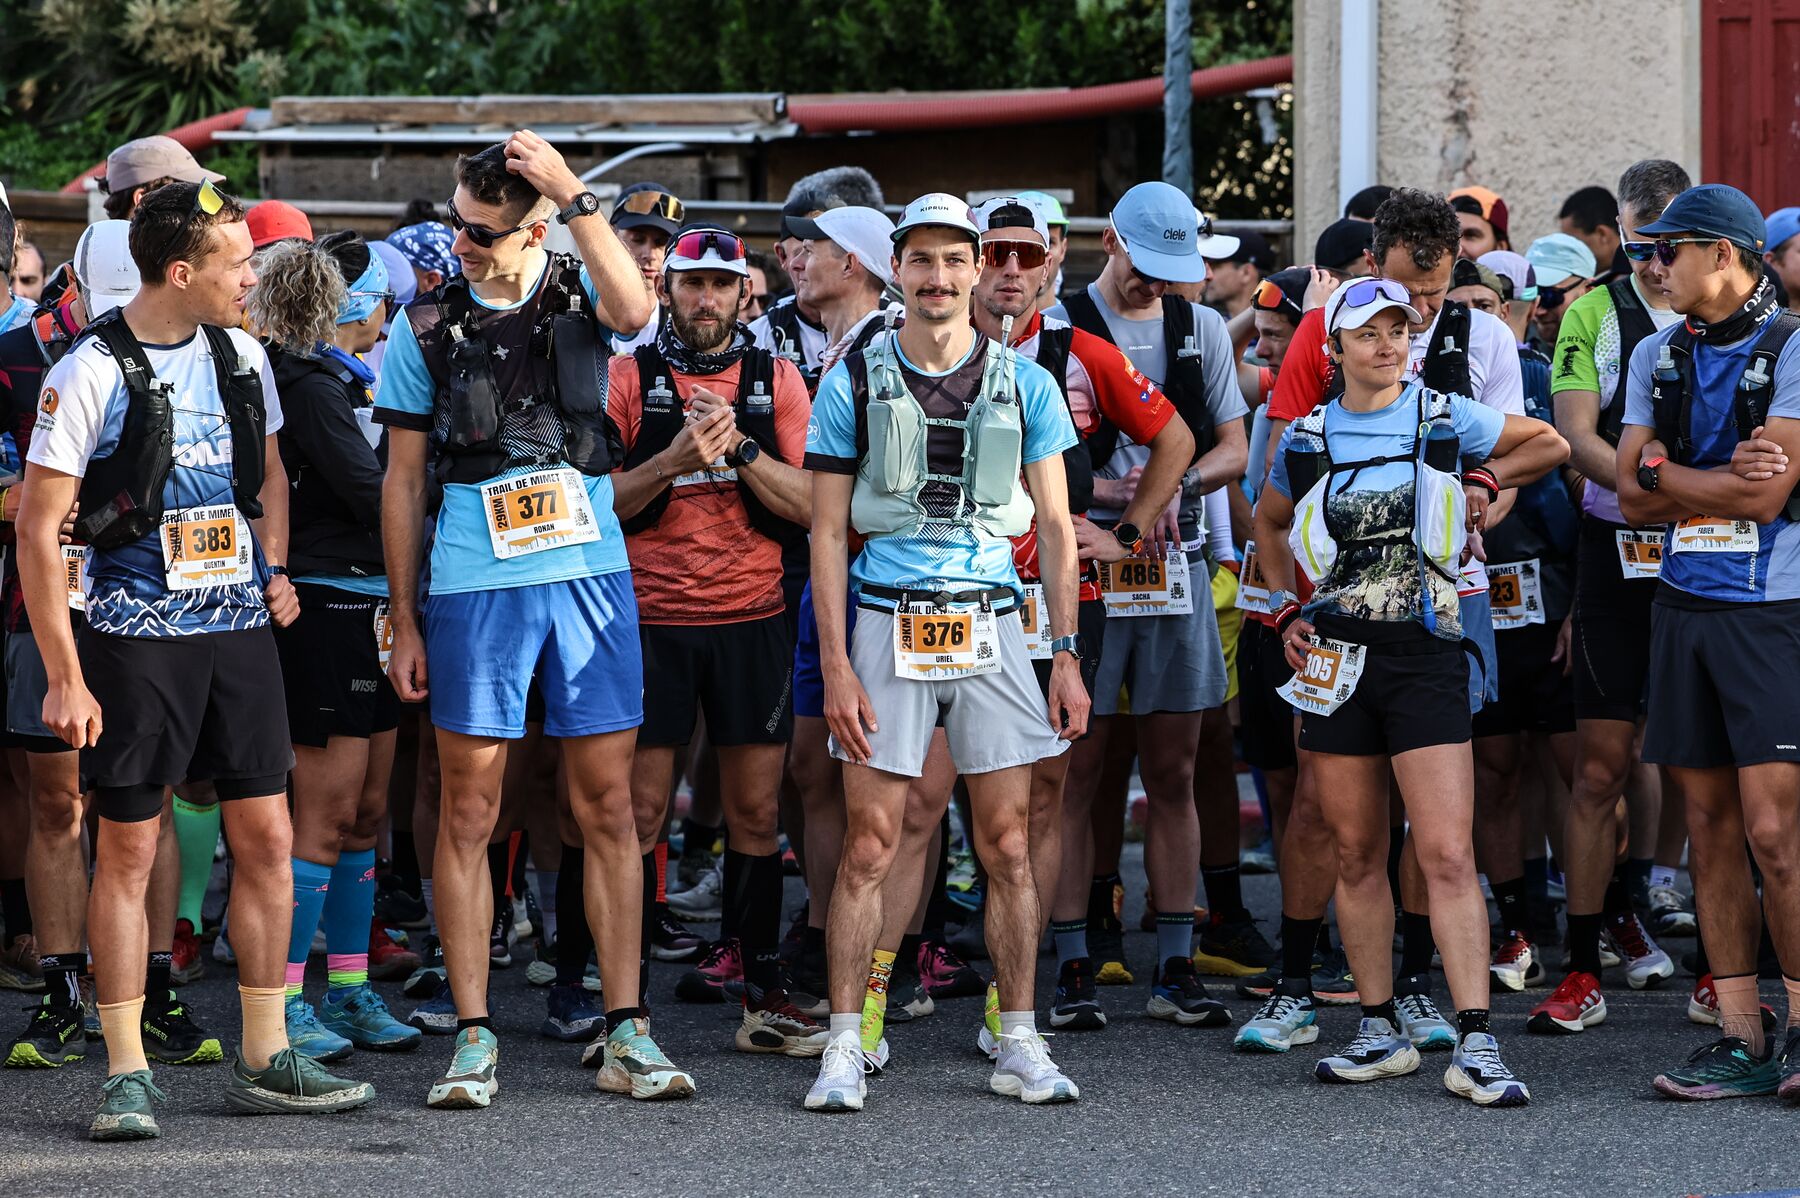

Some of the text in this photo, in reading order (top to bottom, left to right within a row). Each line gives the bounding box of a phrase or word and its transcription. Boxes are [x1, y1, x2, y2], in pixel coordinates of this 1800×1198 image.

[487, 473, 560, 496] TRAIL DE MIMET
[194, 510, 206, 520] DE
[208, 508, 234, 520] MIMET
[492, 498, 508, 528] 29KM
[518, 490, 557, 520] 377
[192, 526, 231, 554] 383
[534, 523, 555, 534] RONAN
[1647, 535, 1658, 543] DE
[66, 548, 84, 558] TRA
[68, 561, 78, 590] 29KM
[204, 560, 226, 570] QUENTIN
[1120, 564, 1160, 586] 486
[1748, 553, 1757, 591] SALOMON
[926, 606, 937, 614] DE
[902, 618, 912, 650] 29KM
[922, 622, 964, 647] 376
